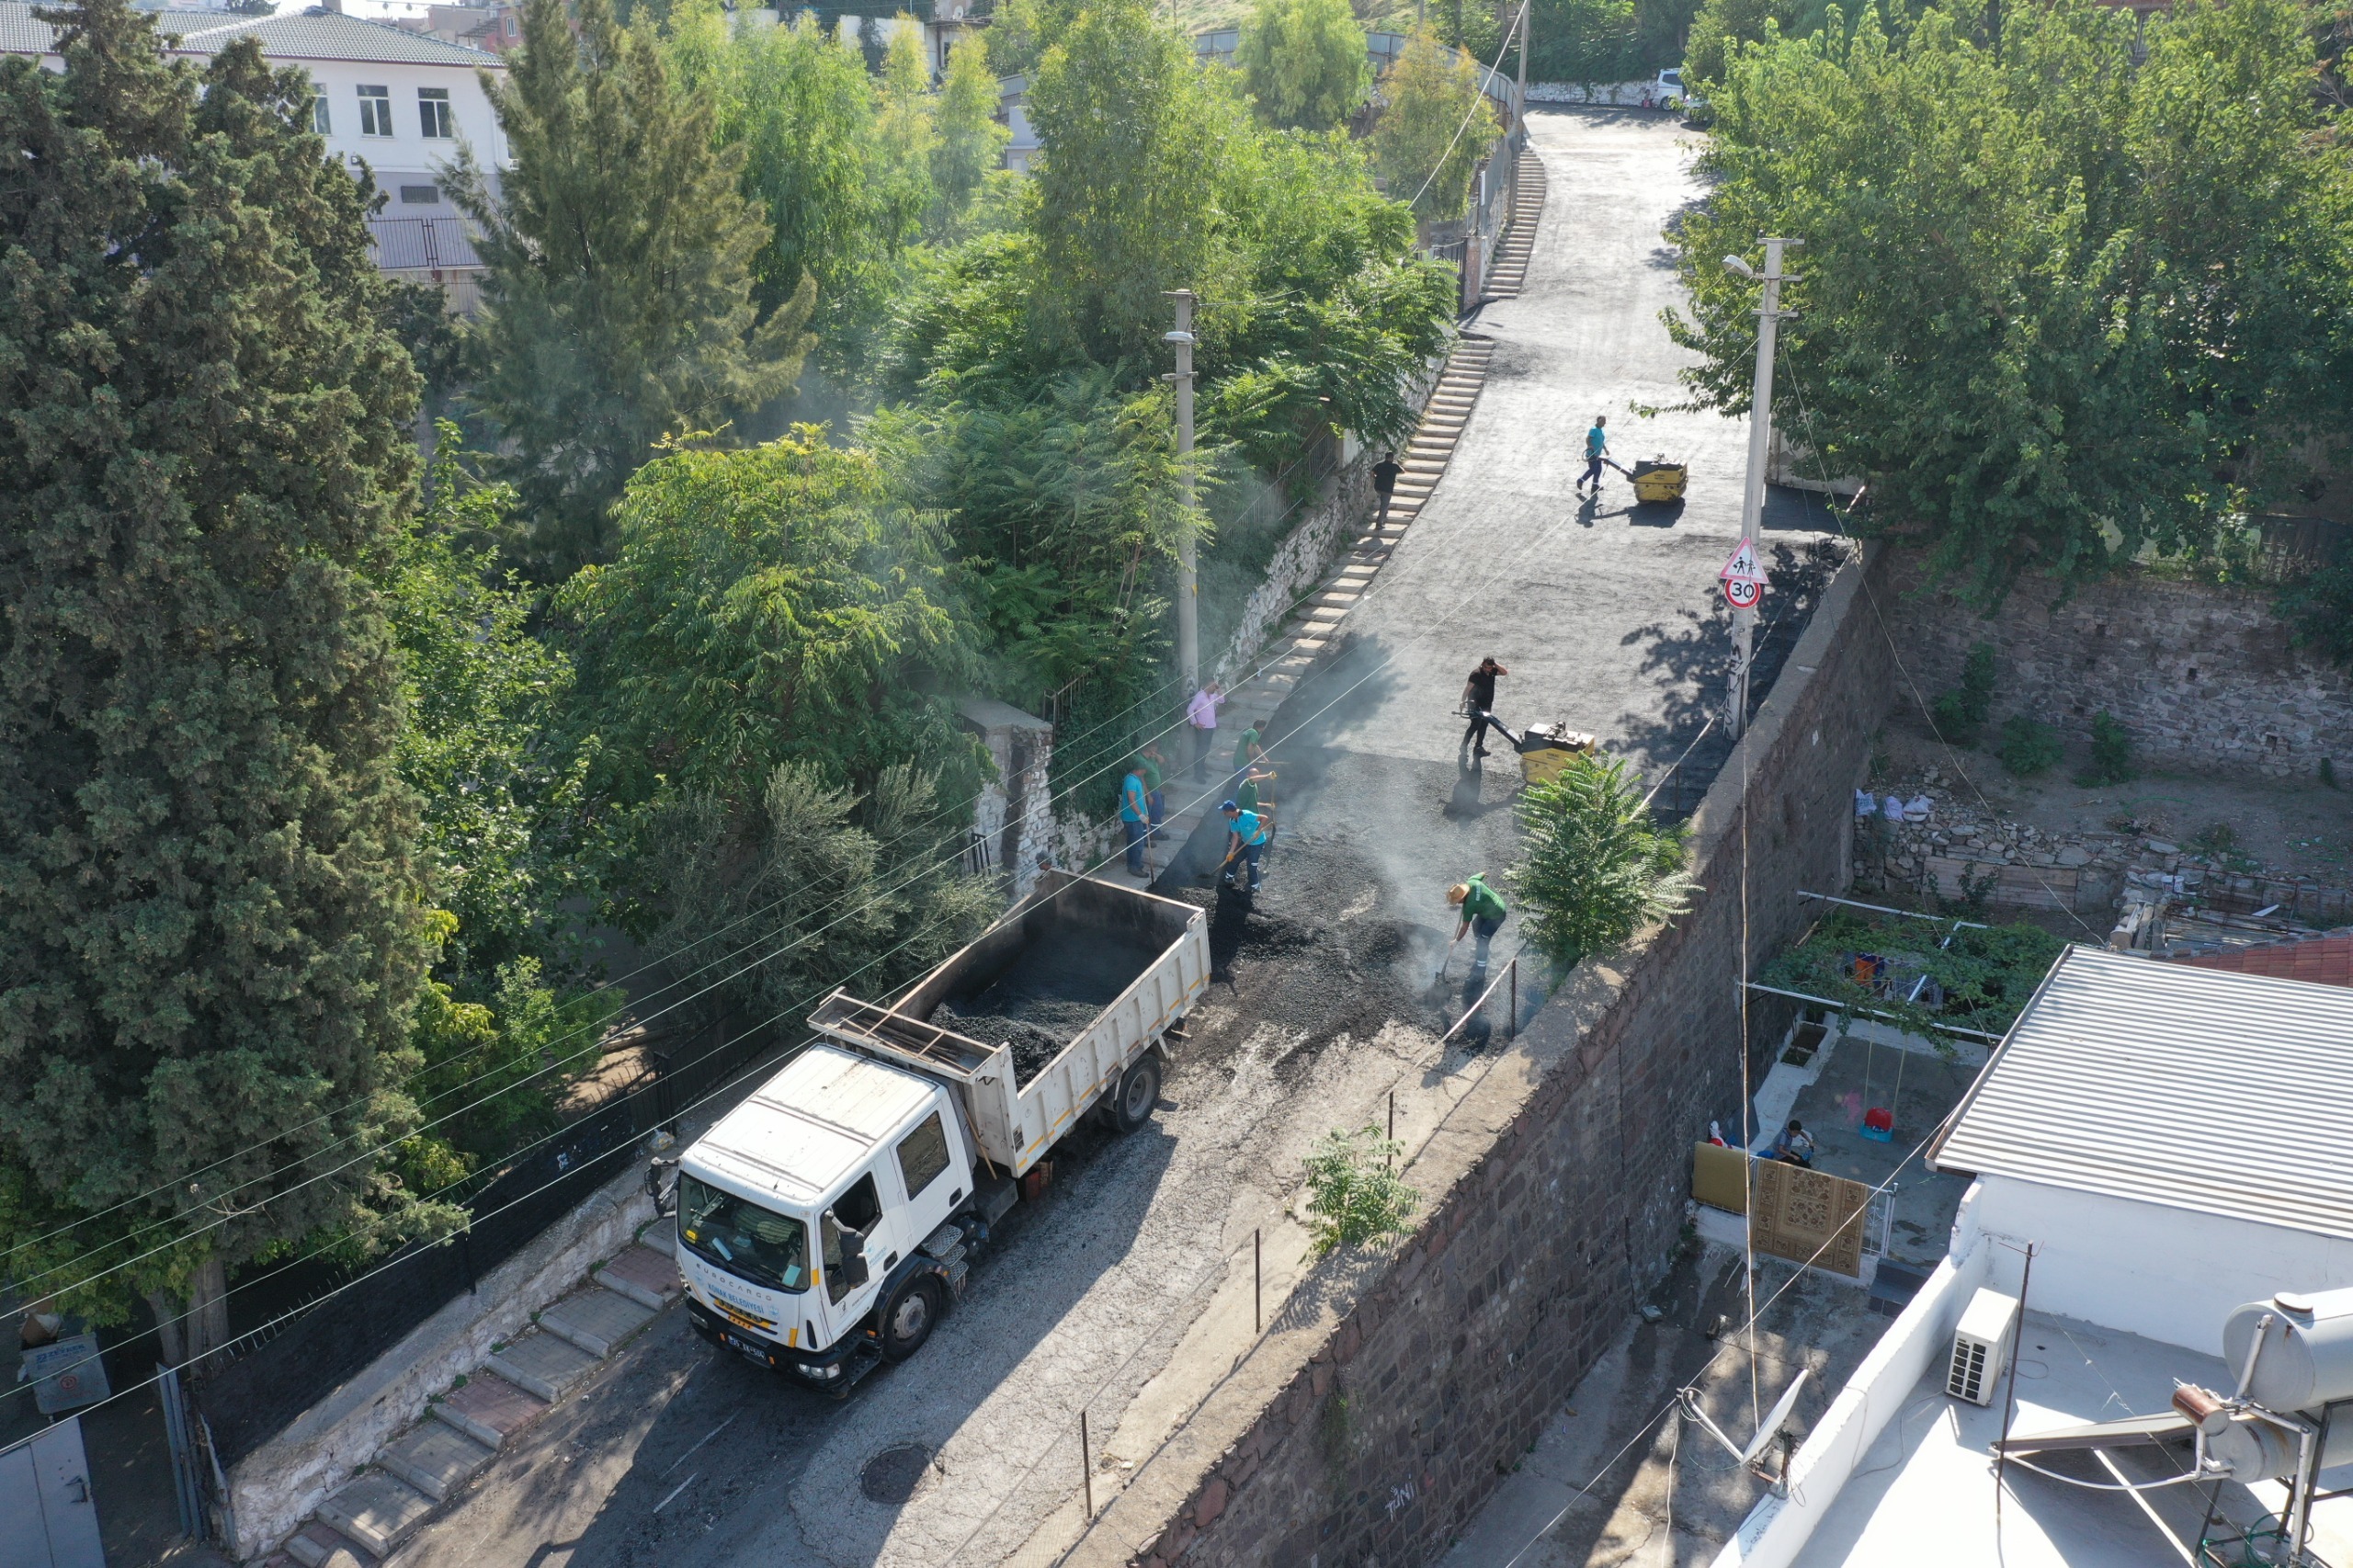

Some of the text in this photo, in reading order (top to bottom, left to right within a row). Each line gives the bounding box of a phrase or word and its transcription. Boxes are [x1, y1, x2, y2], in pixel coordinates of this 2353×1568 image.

[1732, 582, 1755, 598] 30
[696, 1262, 773, 1301] EUROCARGO
[707, 1282, 727, 1298] KONAK
